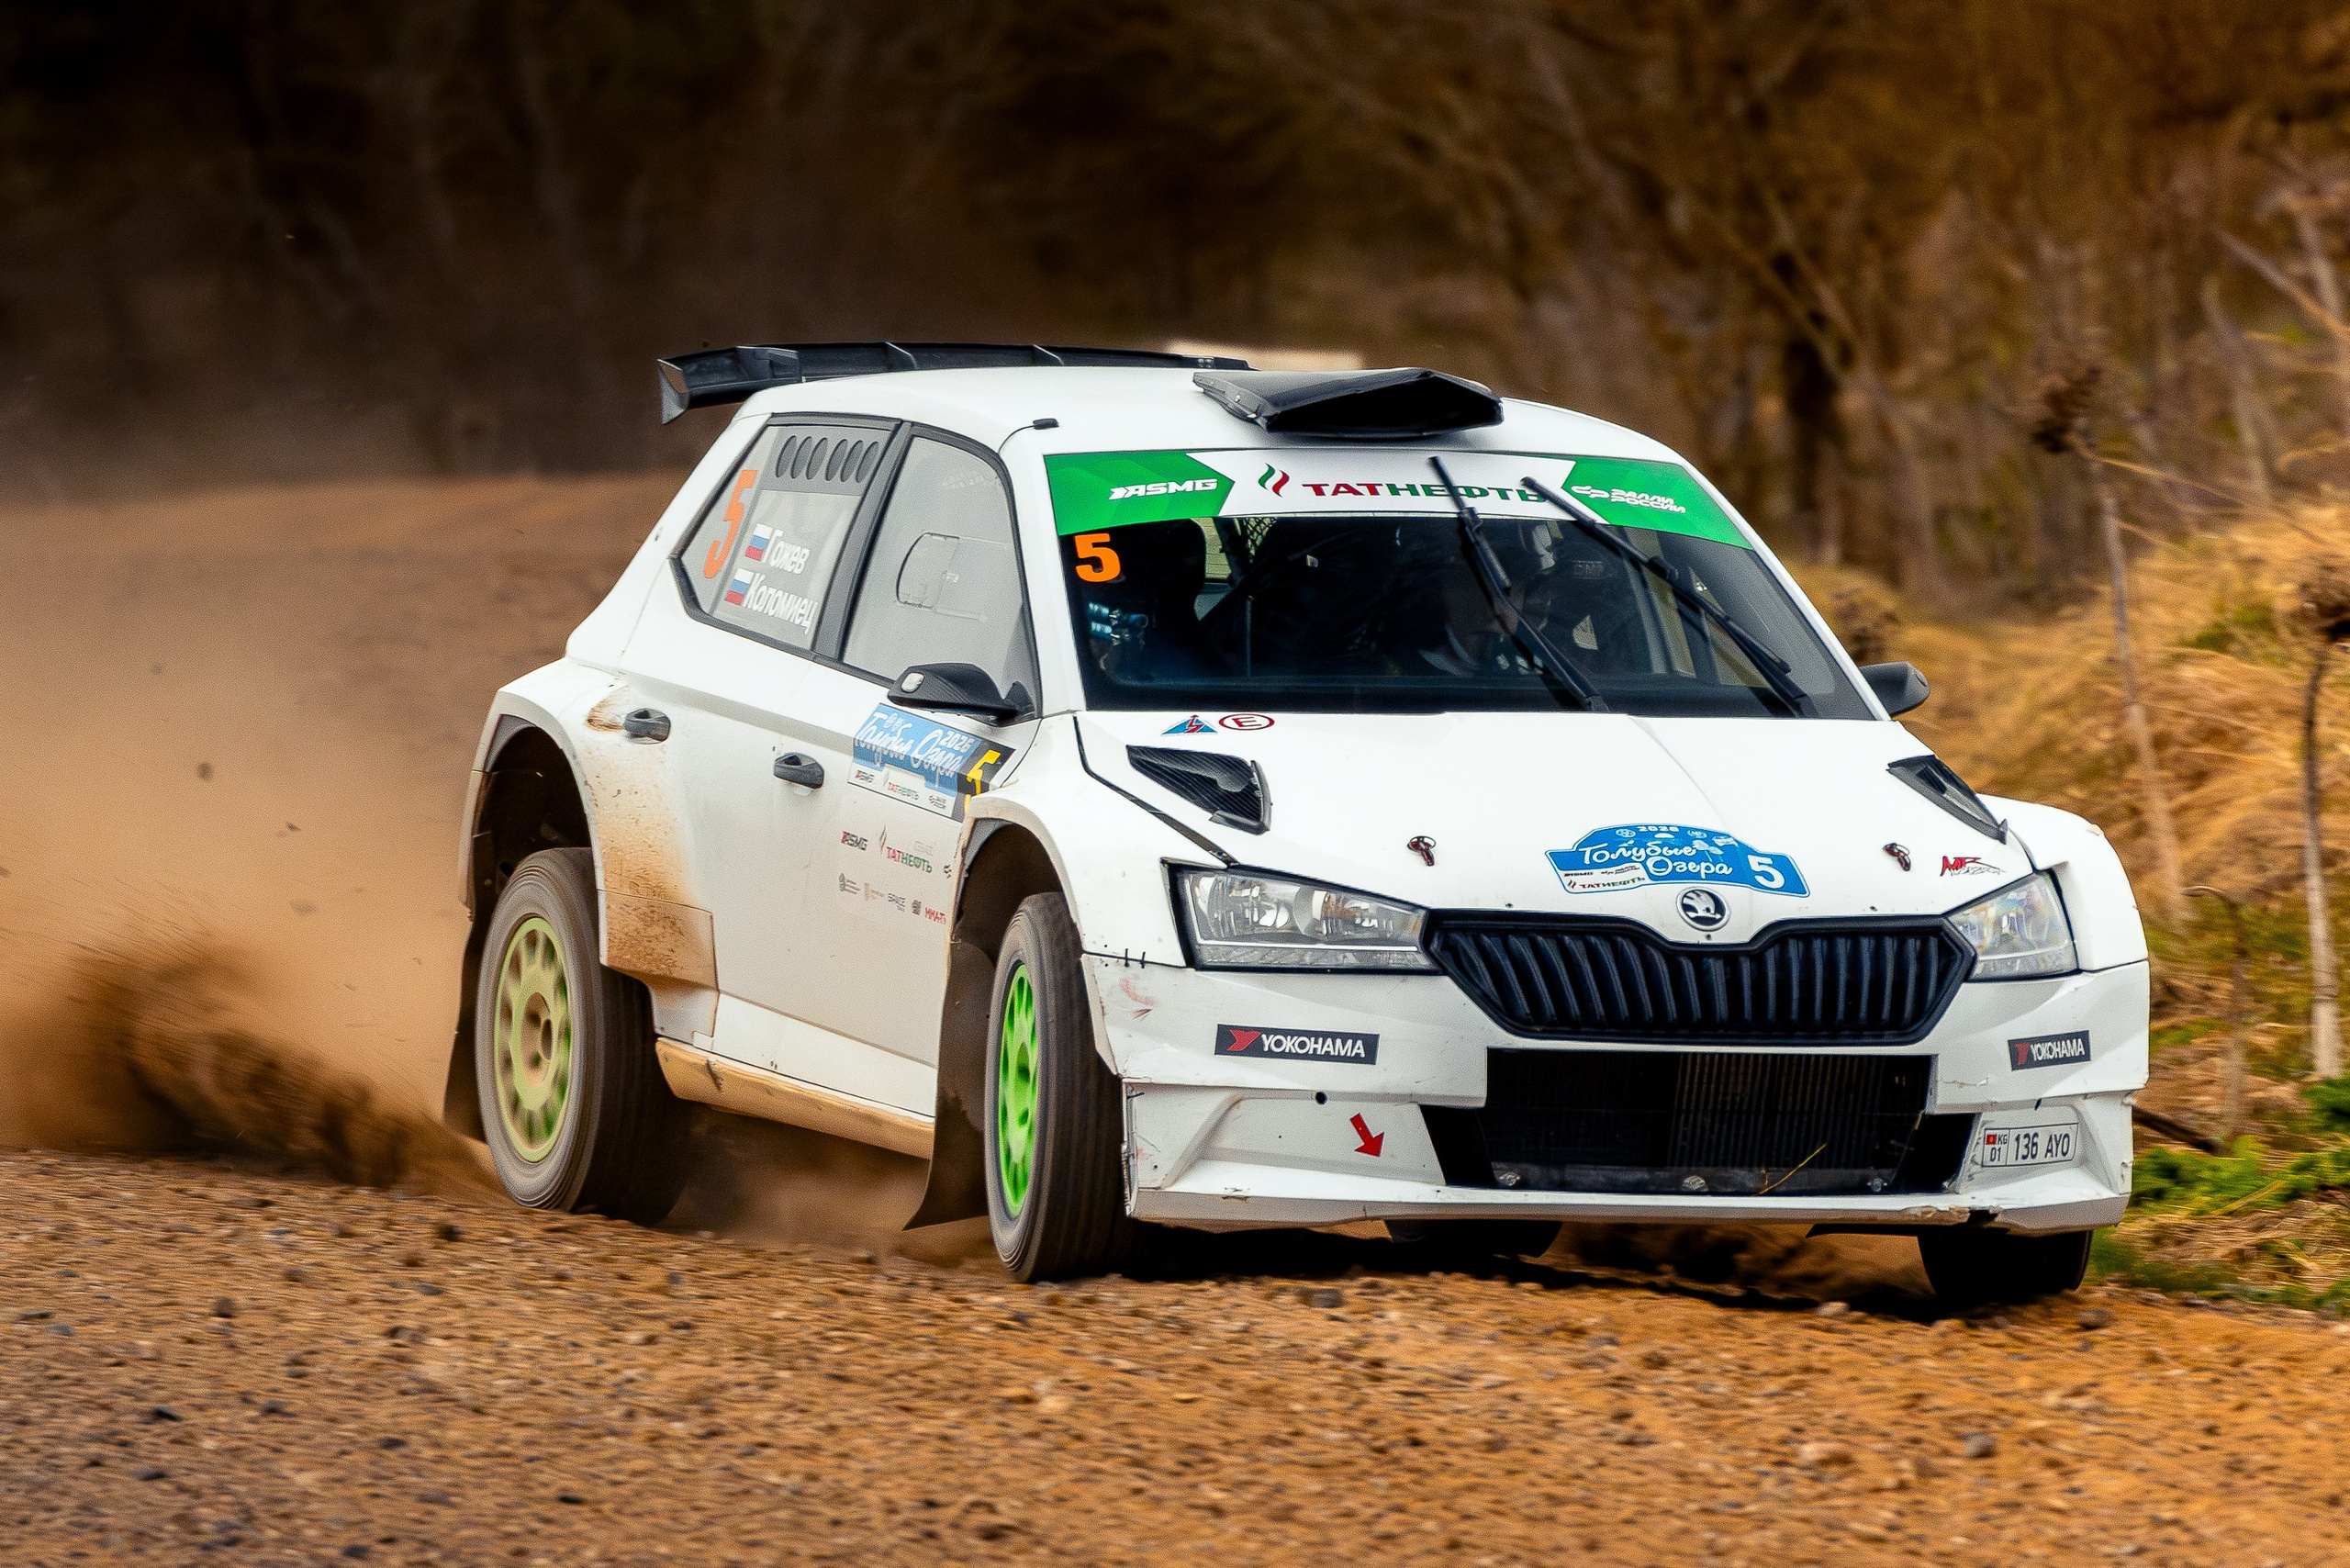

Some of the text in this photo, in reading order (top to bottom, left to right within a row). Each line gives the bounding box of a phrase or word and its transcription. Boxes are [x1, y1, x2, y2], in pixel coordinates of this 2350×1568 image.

[1302, 483, 1549, 502] ТАТНЕФТЬ
[703, 470, 758, 578] 5
[761, 529, 811, 575] Гожев
[1074, 532, 1121, 582] 5
[743, 572, 819, 634] Коломиец
[886, 846, 933, 874] ТАТНЕФТЬ
[1578, 840, 1696, 865] Голубые
[1646, 856, 1733, 879] Озера
[1747, 855, 1785, 889] 5
[1260, 1034, 1365, 1058] YOKOHAMA
[2030, 1038, 2086, 1061] YOKOHAMA
[1998, 1132, 2008, 1145] KG
[2014, 1133, 2040, 1160] 136
